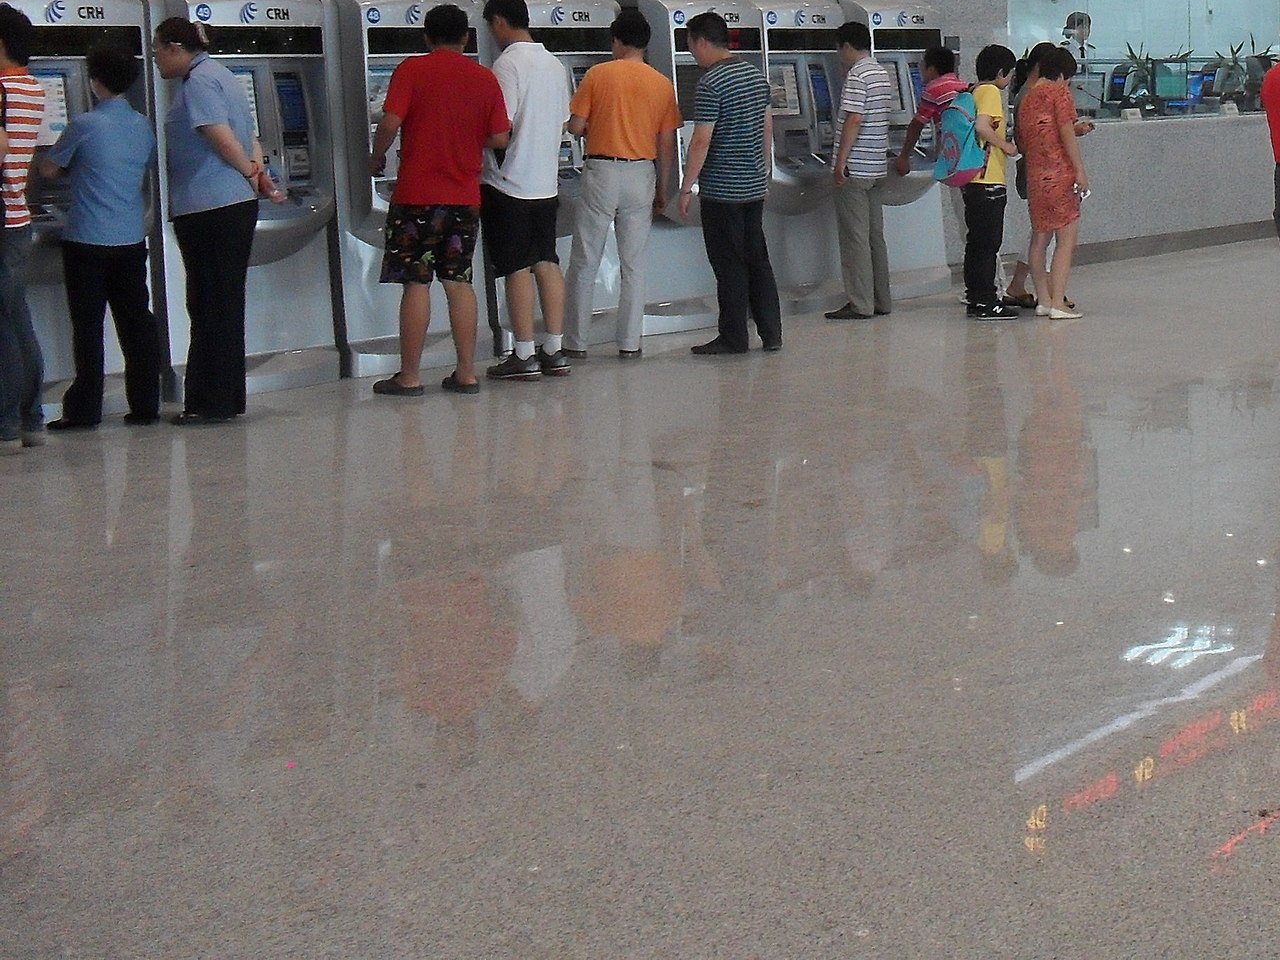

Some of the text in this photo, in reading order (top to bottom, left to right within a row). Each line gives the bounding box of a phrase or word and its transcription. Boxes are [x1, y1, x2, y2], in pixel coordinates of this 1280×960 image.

[77, 6, 105, 19] CRH
[266, 8, 289, 20] CRH
[572, 11, 590, 22] CRH
